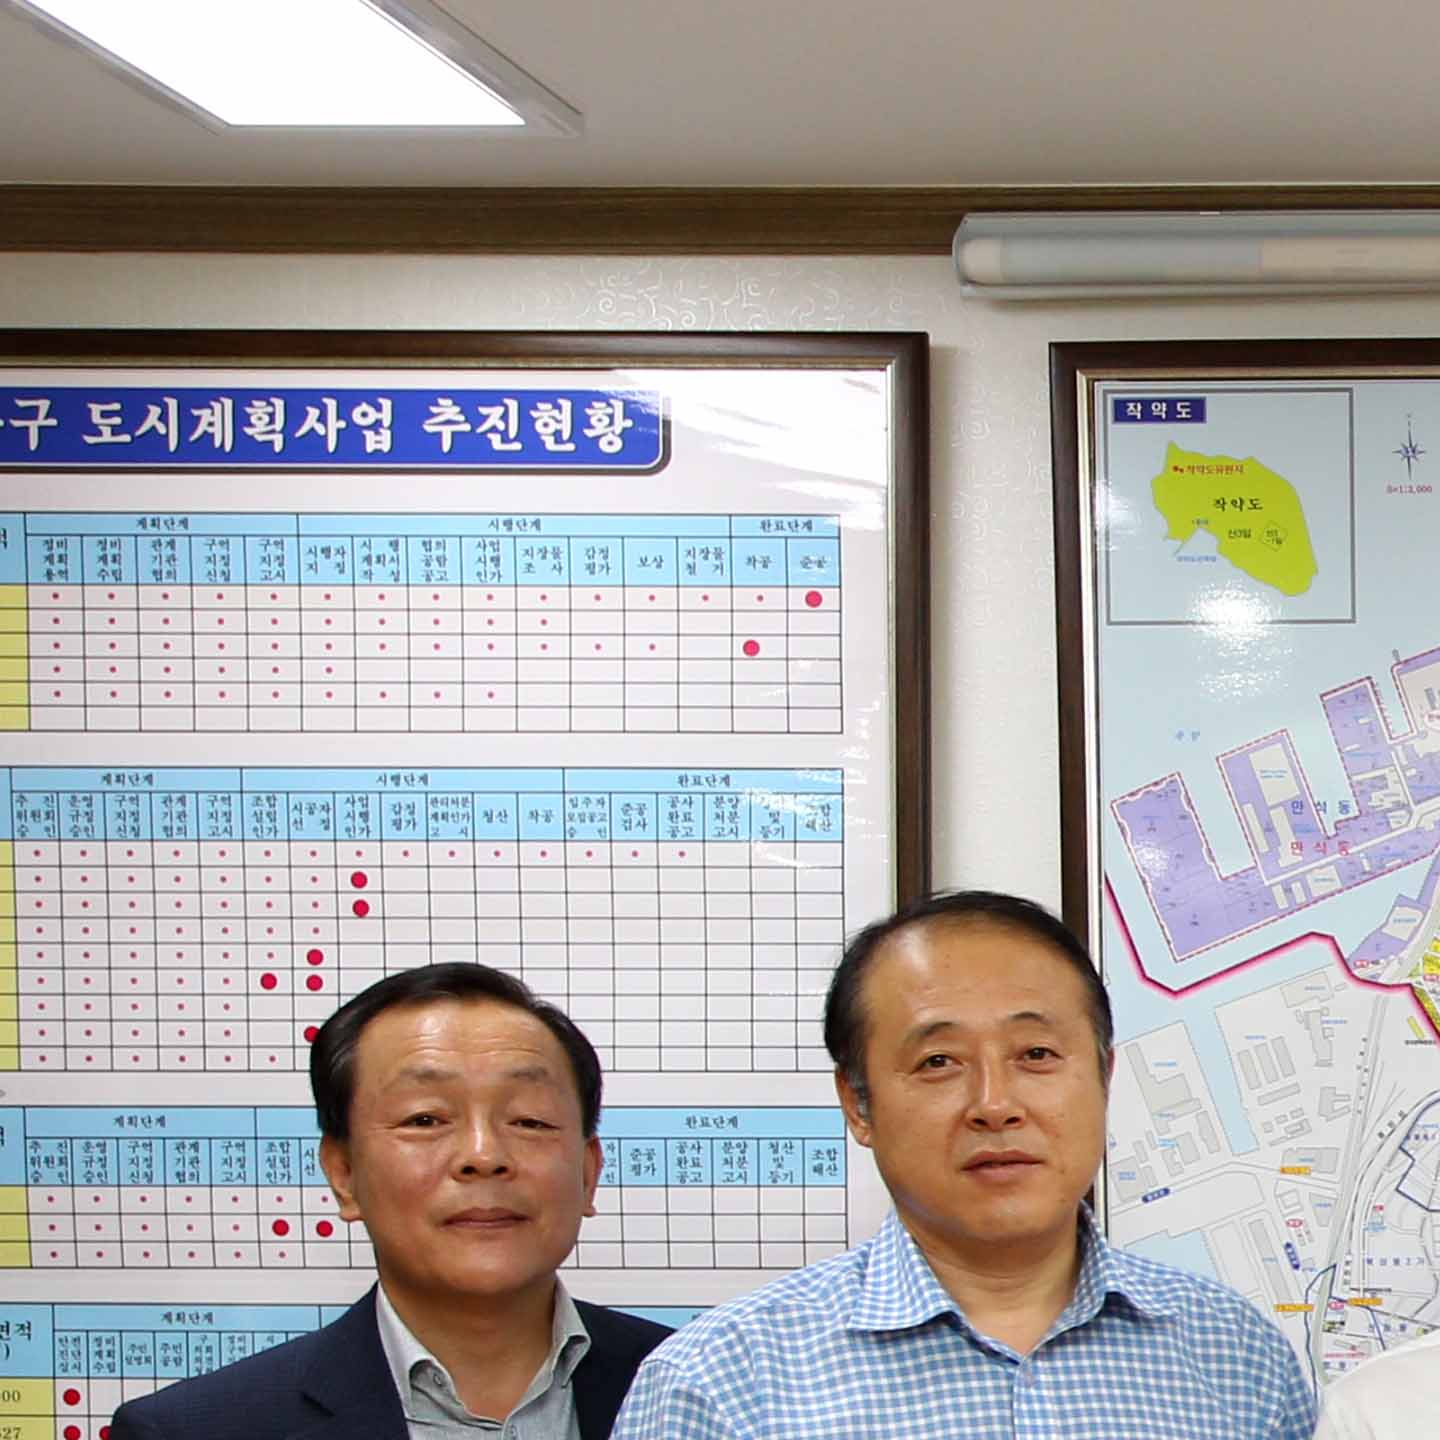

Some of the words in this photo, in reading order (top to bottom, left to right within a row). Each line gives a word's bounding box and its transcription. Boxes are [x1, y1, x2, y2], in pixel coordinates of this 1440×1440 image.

[0, 398, 58, 452] 구
[82, 399, 395, 454] 도시계획사업
[423, 397, 633, 455] 추진현황
[1126, 402, 1192, 419] 작약도
